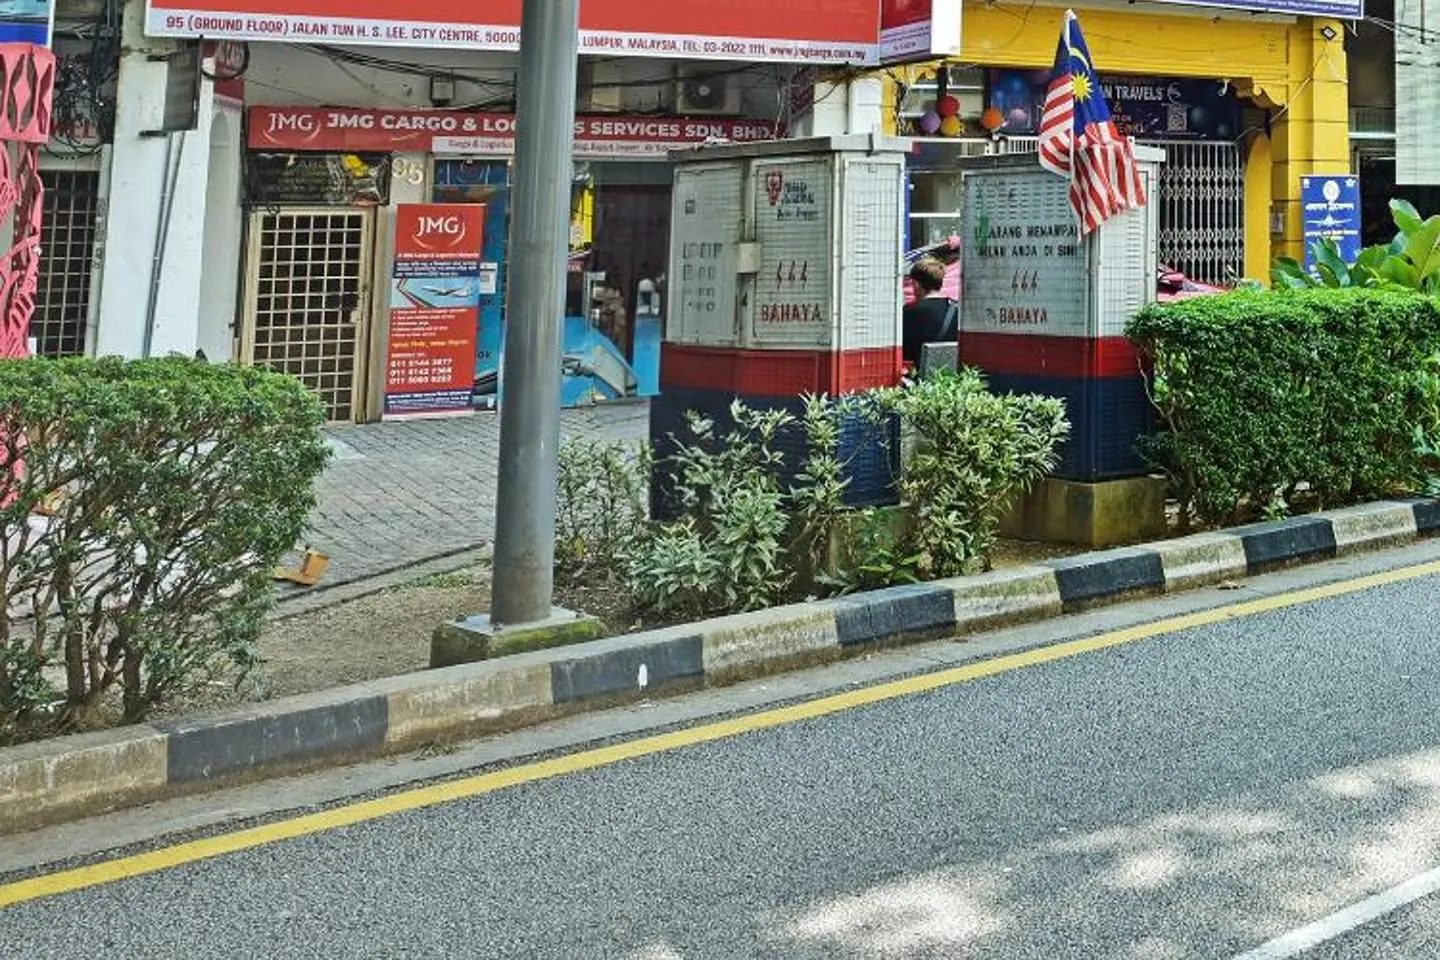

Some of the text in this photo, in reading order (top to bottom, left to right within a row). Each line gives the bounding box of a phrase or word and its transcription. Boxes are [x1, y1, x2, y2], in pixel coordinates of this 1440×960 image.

[166, 17, 184, 30] 95
[187, 17, 243, 32] (GROUND
[246, 19, 289, 35] FLOOR)
[291, 21, 328, 36] JALAN
[331, 23, 354, 36] TUN
[411, 26, 436, 40] CITY
[1115, 85, 1163, 101] TRAVELS
[268, 113, 313, 132] JMG
[327, 113, 374, 129] JMG
[380, 114, 459, 131] CARGO
[462, 117, 477, 130] &
[590, 120, 680, 137] SERVICES
[684, 123, 728, 138] SDN.
[416, 217, 459, 237] JMG
[761, 303, 823, 322] BAHAYA
[1000, 307, 1048, 324] BAHAYA
